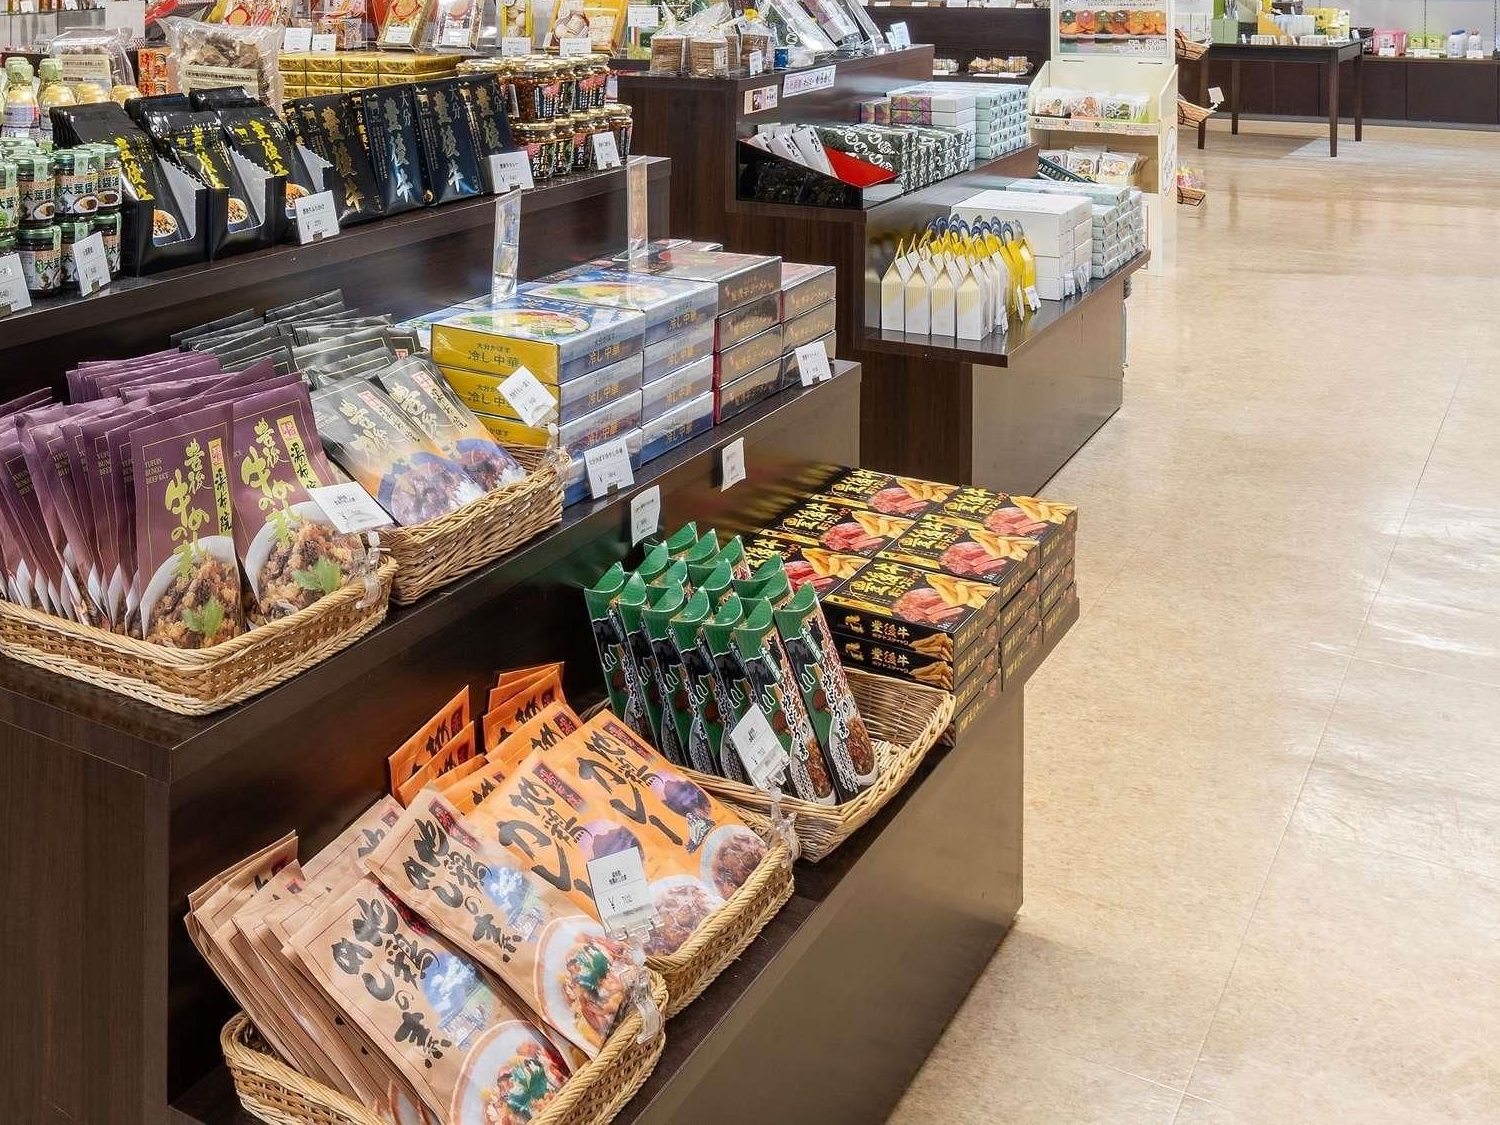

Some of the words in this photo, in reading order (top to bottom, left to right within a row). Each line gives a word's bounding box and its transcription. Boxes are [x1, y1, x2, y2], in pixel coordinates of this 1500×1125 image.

[476, 342, 512, 354] 大分かぼす
[467, 349, 522, 367] 冷し中華
[871, 619, 911, 639] 豊後牛
[871, 646, 911, 667] 豊後牛
